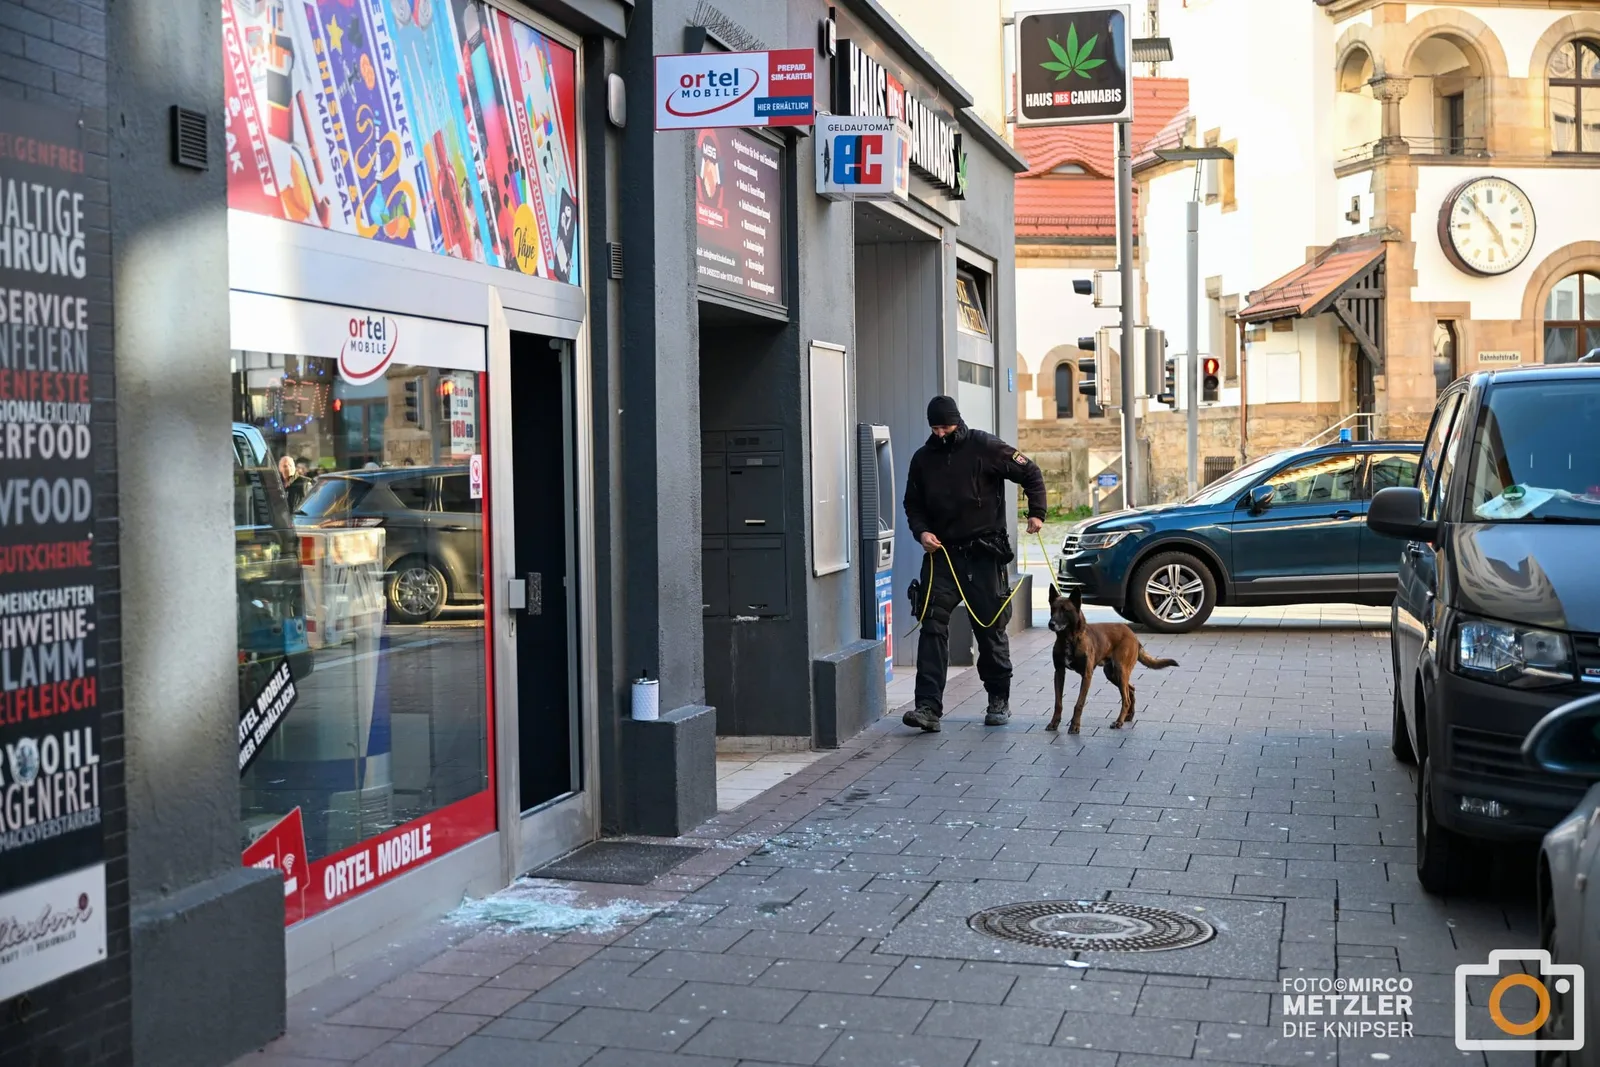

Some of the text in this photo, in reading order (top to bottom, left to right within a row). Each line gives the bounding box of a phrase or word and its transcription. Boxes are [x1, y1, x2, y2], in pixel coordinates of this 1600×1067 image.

[680, 67, 740, 89] ortel
[770, 71, 813, 82] SIM-KARTEN
[777, 63, 806, 72] PREPAID
[681, 87, 740, 98] MOBILE
[757, 101, 809, 111] HIER ERHÄLTLICH
[1025, 88, 1122, 107] HAUS DES CANNABIS
[827, 123, 895, 132] GELDAUTOMAT
[850, 41, 886, 116] HAUS
[904, 90, 956, 190] CANNABIS
[315, 91, 350, 225] MUASSAL
[466, 118, 486, 194] VAPE
[0, 176, 86, 240] ALTIGE
[349, 314, 386, 341] ortel
[350, 340, 387, 355] MOBILE
[1479, 353, 1519, 361] Bahnhofstraße
[0, 608, 96, 650] HWEINE-
[2, 638, 96, 692] LAMM-
[256, 662, 291, 716] MOBILE
[253, 682, 296, 747] ERHÄLTLICH
[324, 823, 432, 901] ORTEL MOBILE
